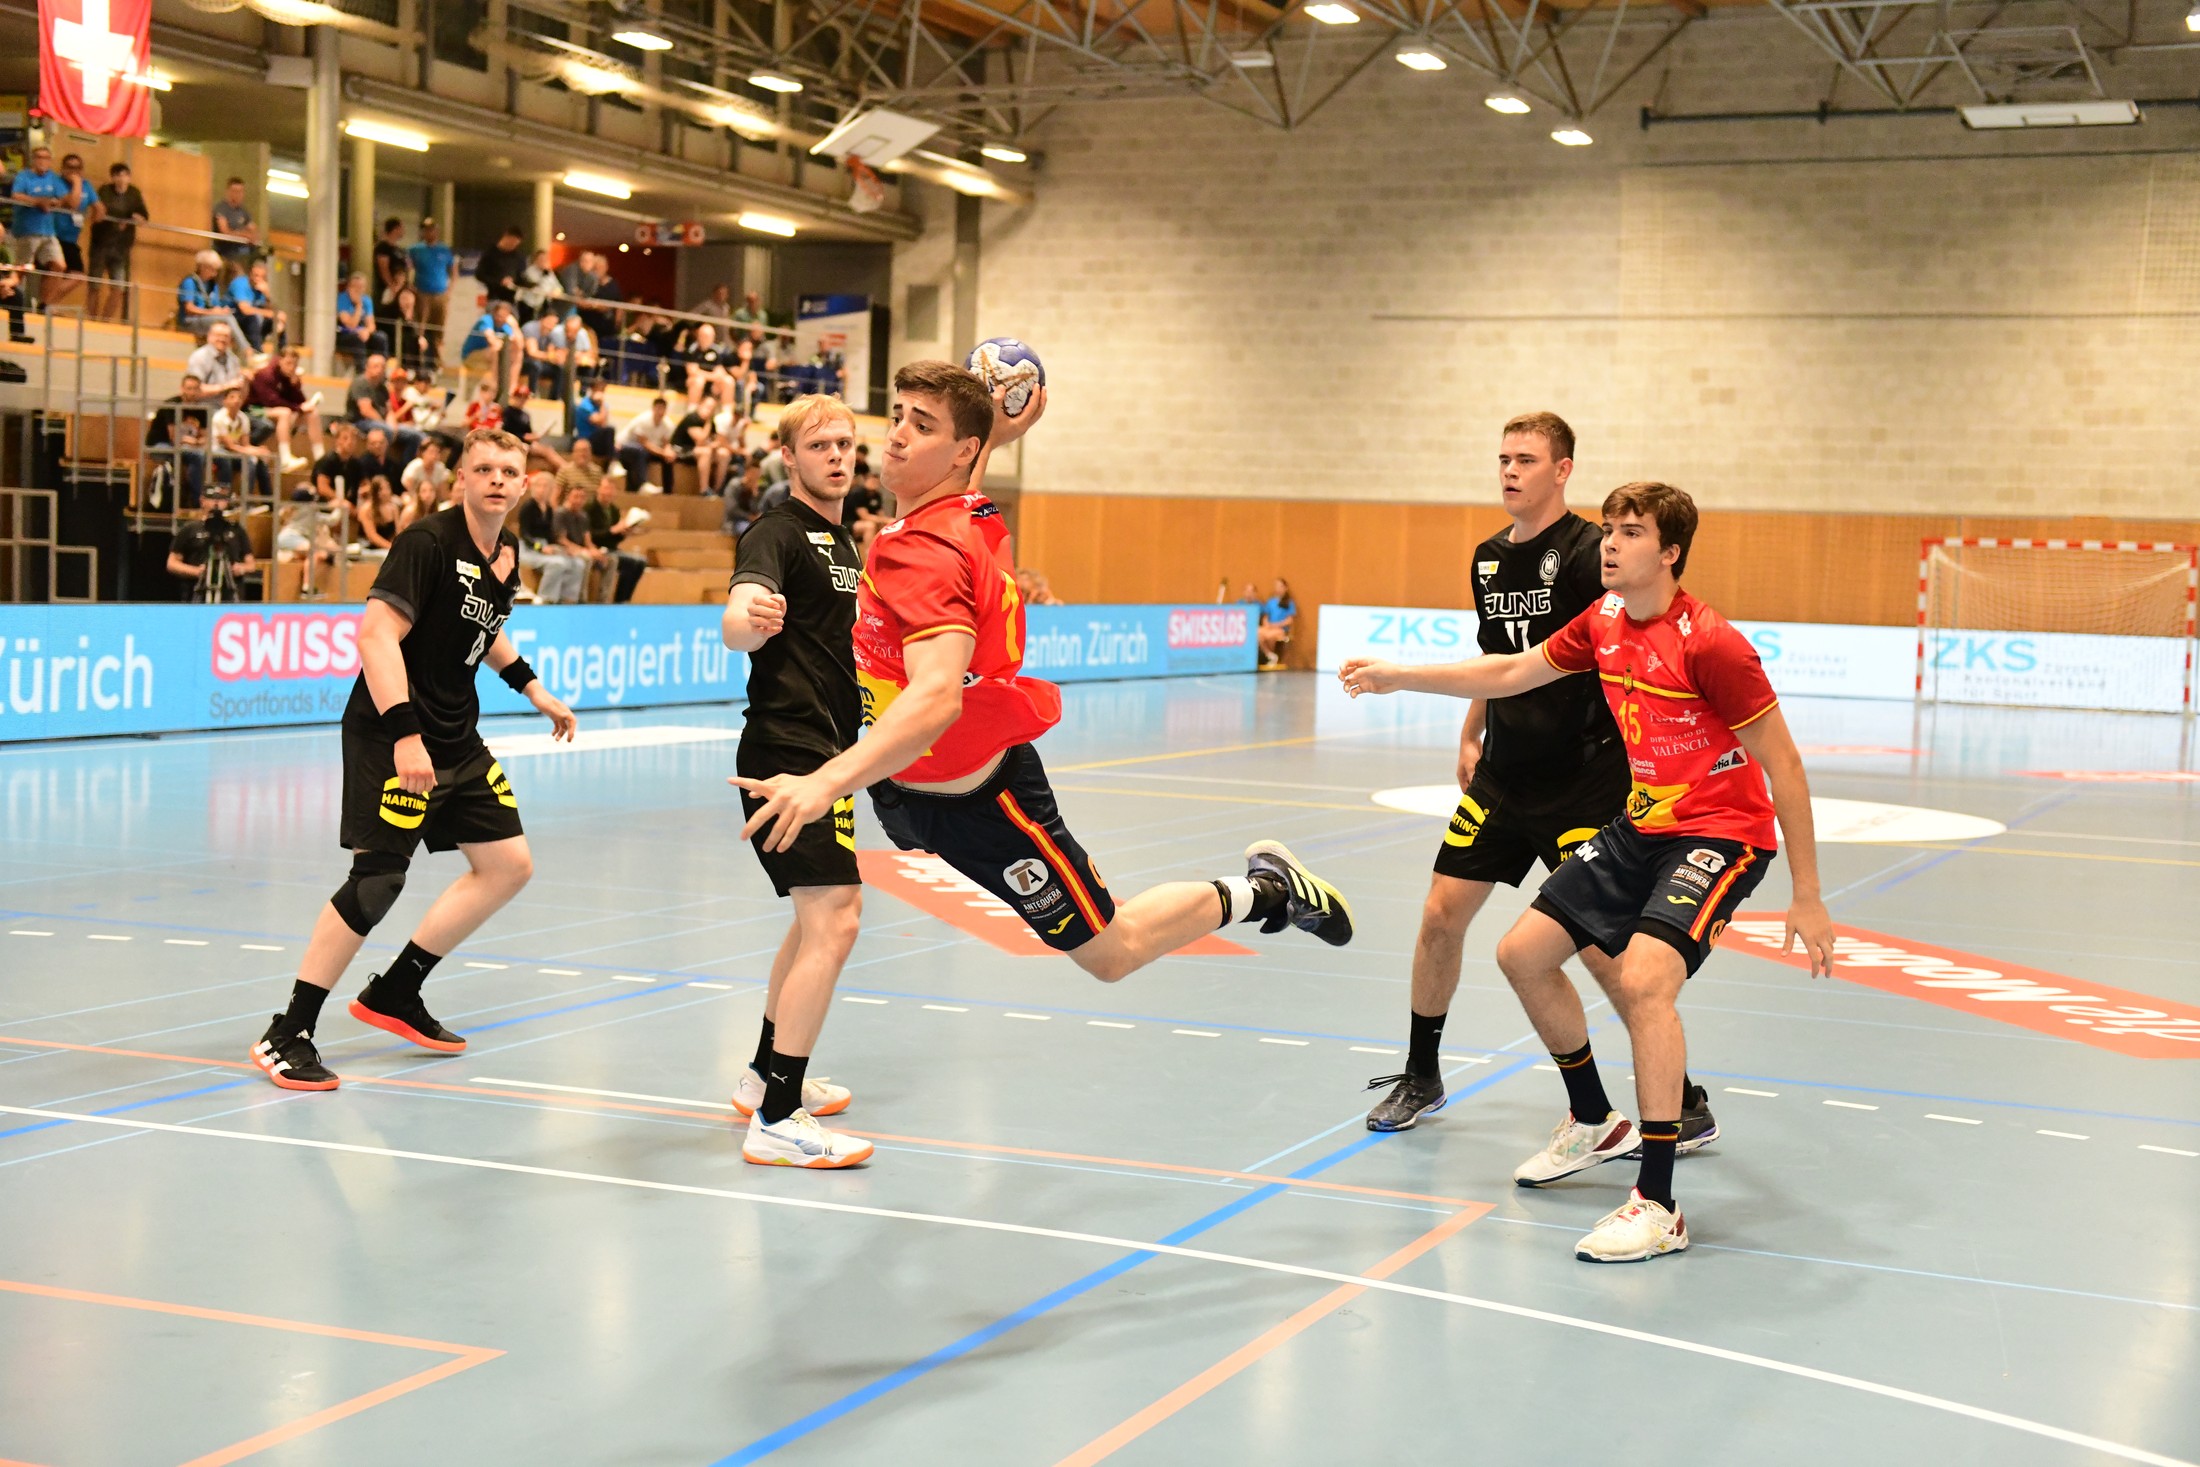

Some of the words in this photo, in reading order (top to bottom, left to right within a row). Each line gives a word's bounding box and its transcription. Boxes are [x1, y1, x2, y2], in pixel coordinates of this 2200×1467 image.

[1484, 588, 1552, 620] JUNG
[1025, 626, 1081, 668] anton
[1087, 621, 1148, 666] Zürich
[1168, 614, 1247, 645] SWISSLOS
[1367, 614, 1460, 647] ZKS
[217, 620, 361, 674] SWISS
[1929, 636, 2037, 672] ZKS
[0, 633, 153, 714] ürich
[511, 628, 682, 707] Engagiert
[692, 628, 728, 684] für
[209, 690, 313, 722] Sportfonds
[1618, 700, 1642, 745] 15
[1652, 736, 1710, 757] VALÈNCIA
[1711, 759, 1730, 771] etia
[381, 793, 427, 811] HARTING
[1675, 868, 1711, 889] ANTEQUERA
[1023, 888, 1062, 911] ANTEQUERA
